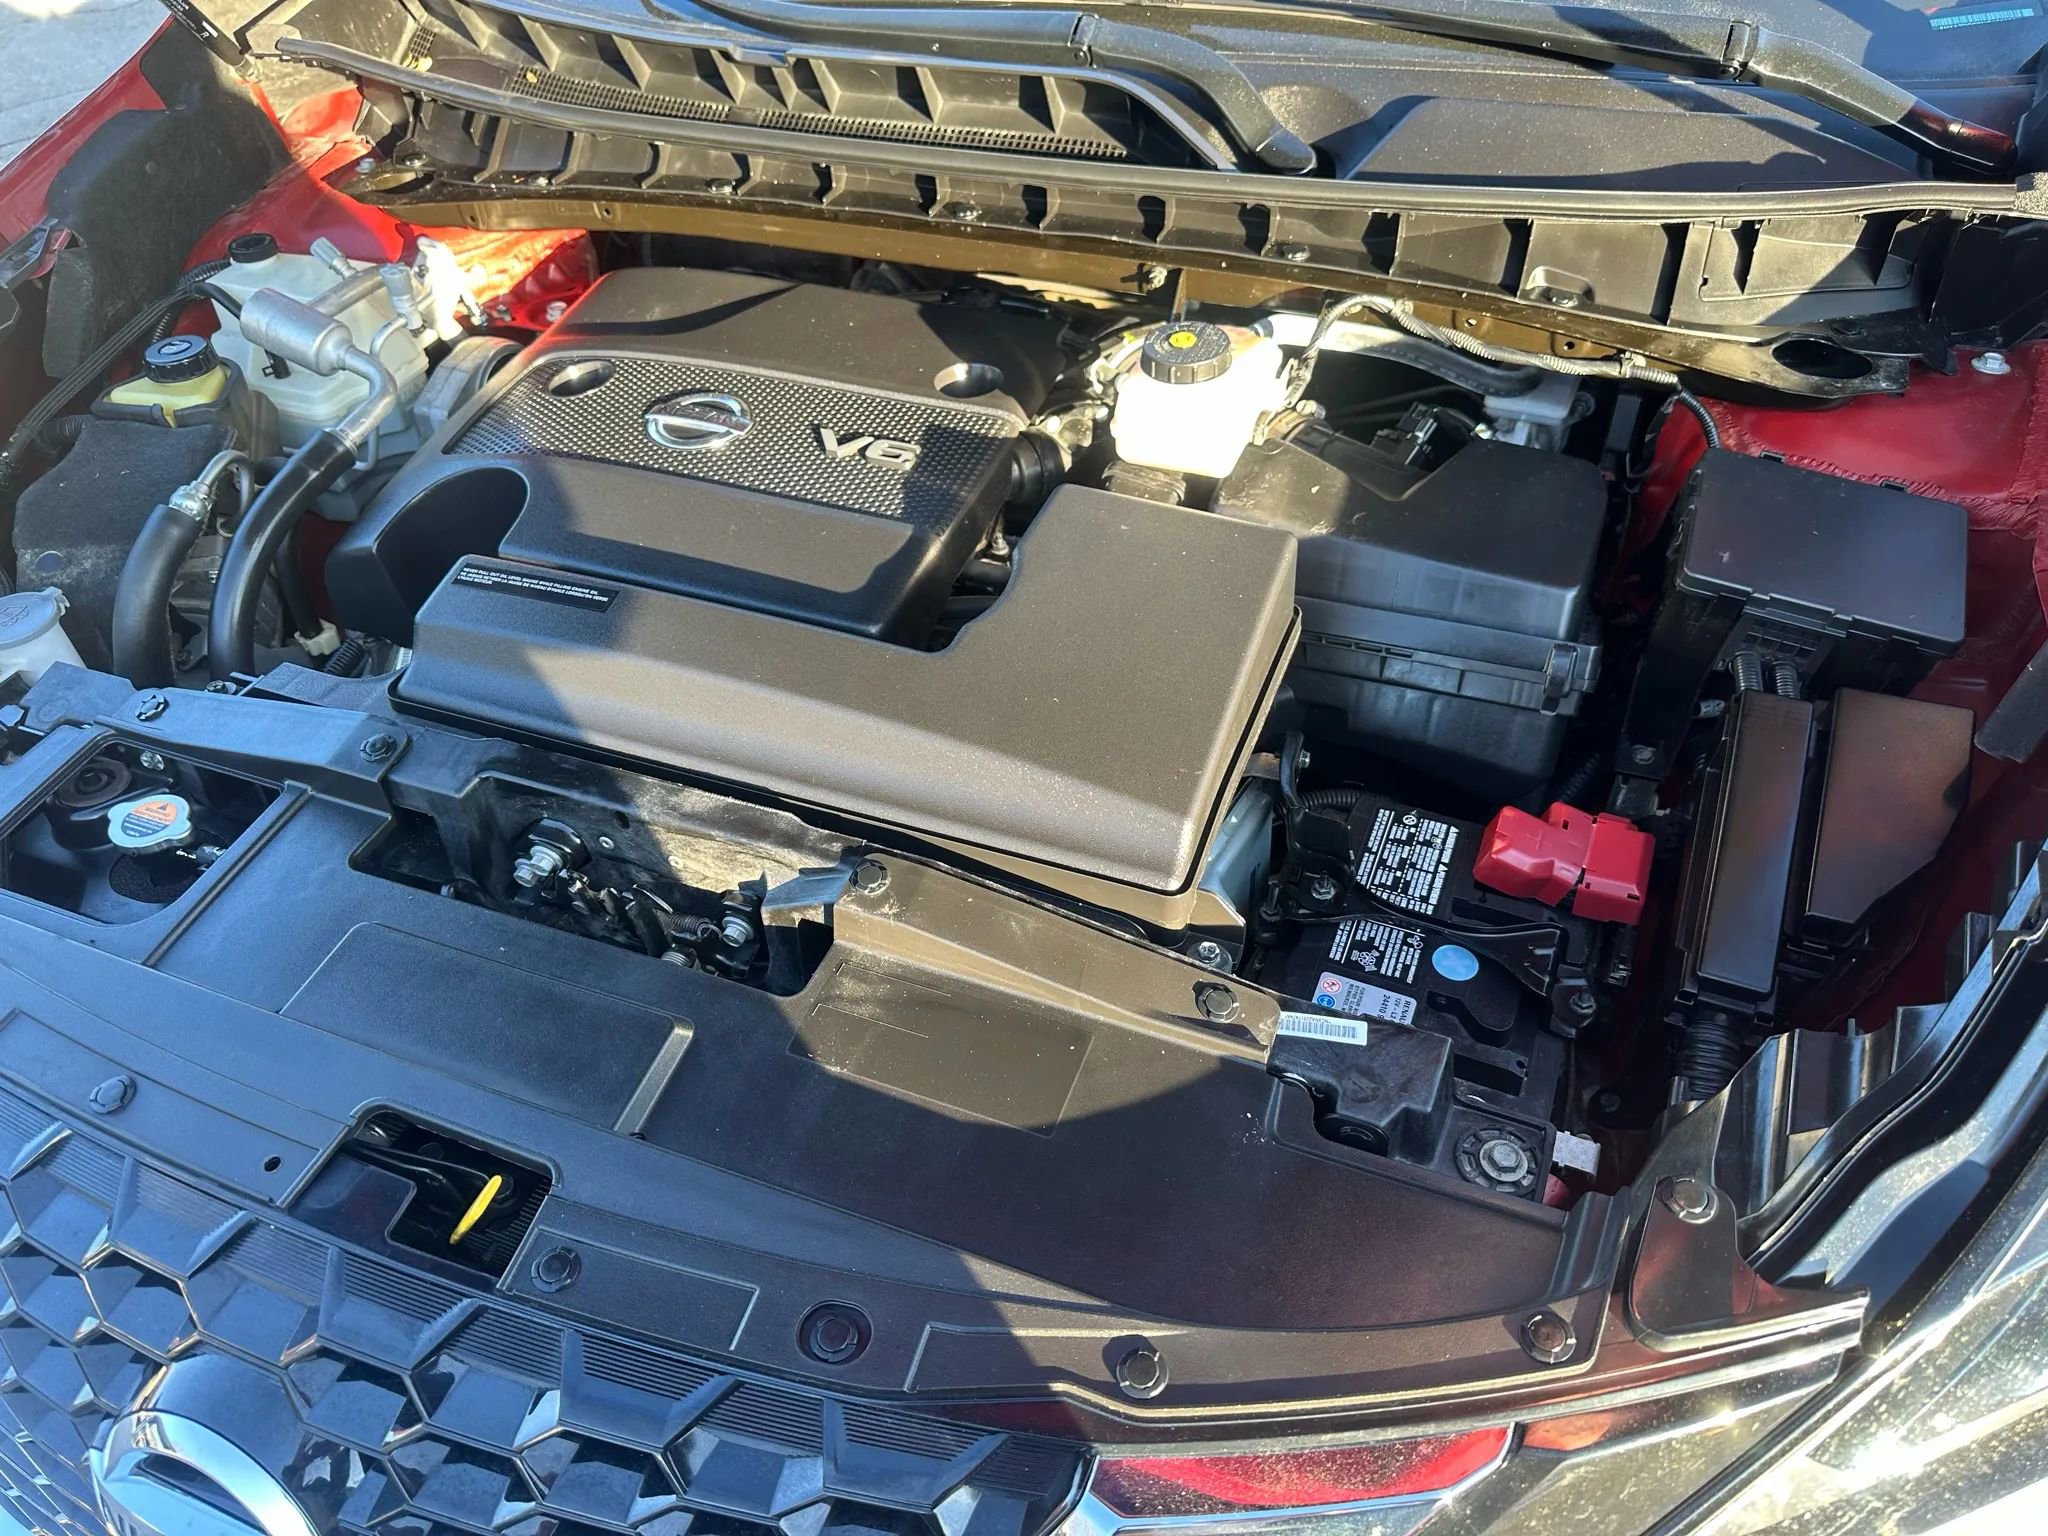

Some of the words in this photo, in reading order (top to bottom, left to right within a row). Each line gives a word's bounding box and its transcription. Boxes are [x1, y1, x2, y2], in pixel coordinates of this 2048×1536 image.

[819, 426, 922, 471] V6
[1379, 994, 1391, 1013] 24410
[1399, 1000, 1411, 1023] RENAU
